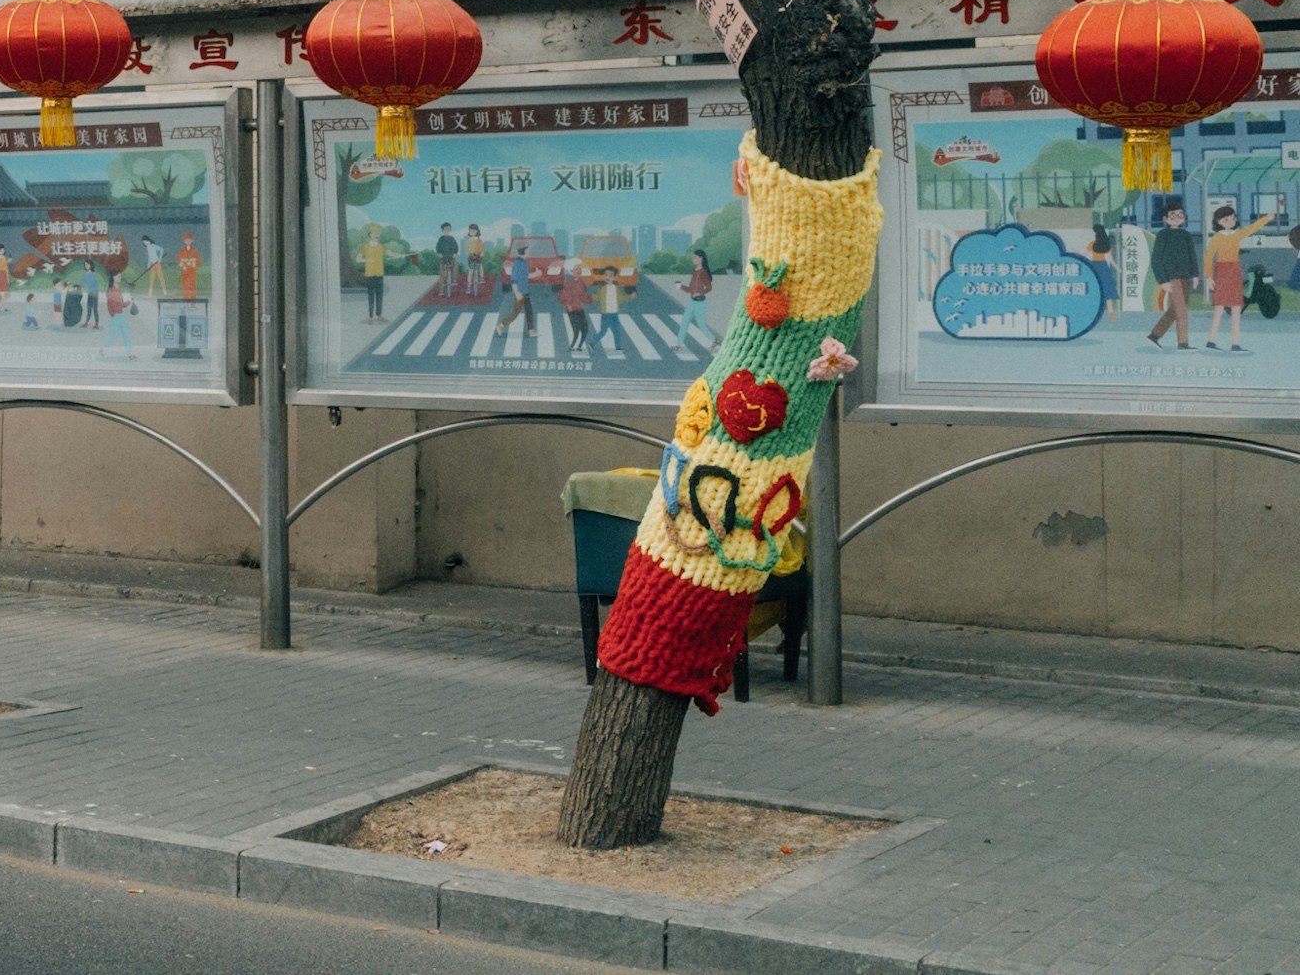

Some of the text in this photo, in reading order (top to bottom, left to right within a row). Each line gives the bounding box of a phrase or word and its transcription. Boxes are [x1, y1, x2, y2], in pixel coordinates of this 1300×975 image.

[427, 103, 670, 132] 创文明城区 建美好家园
[426, 162, 663, 195] 礼让有序 文明随行
[37, 220, 108, 236] 让城市更文明
[51, 241, 123, 256] 让生活更美好
[957, 263, 1081, 277] 手拉手参与文明创建
[962, 282, 1088, 296] 心连心共建幸福家园
